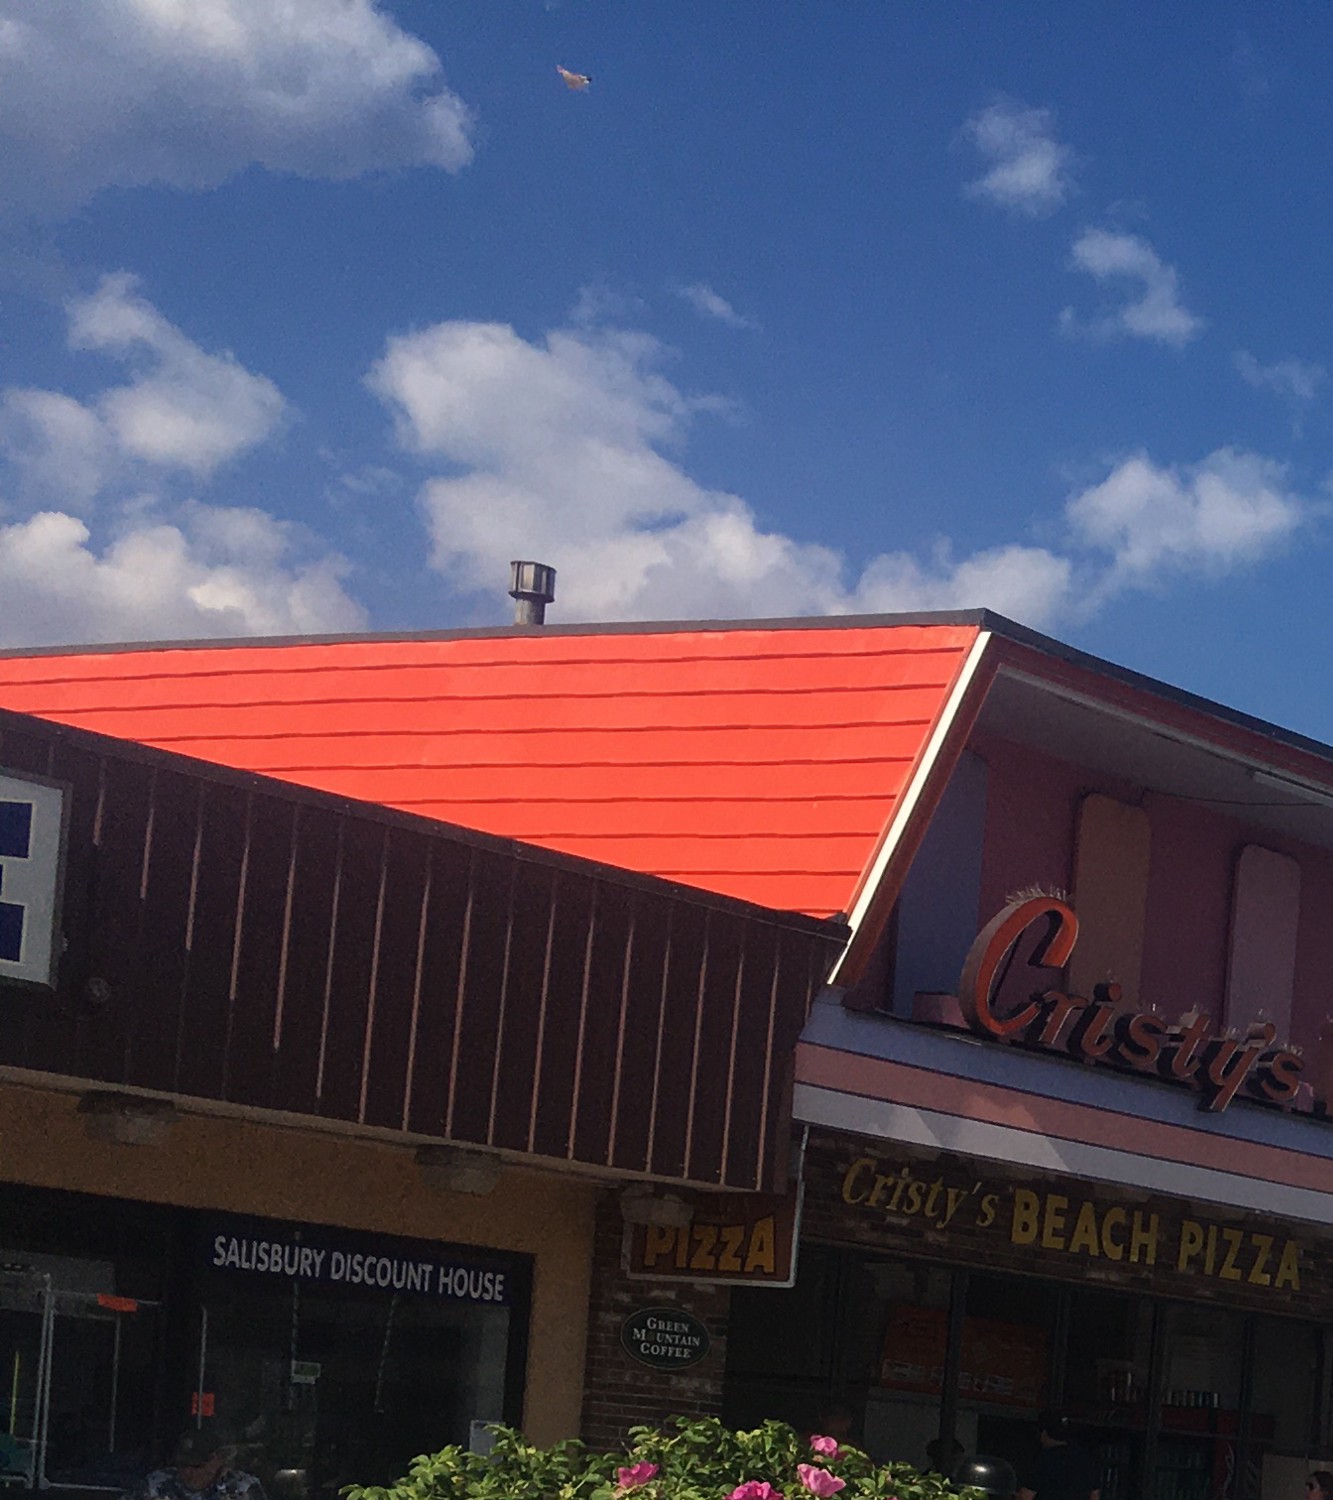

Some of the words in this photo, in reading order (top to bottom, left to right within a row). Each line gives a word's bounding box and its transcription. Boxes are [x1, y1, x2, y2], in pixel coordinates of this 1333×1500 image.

[960, 896, 1304, 1113] Cristy's
[643, 1214, 776, 1274] PIZZA
[841, 1157, 999, 1229] Cristy's
[1010, 1187, 1159, 1265] BEACH
[1178, 1220, 1300, 1291] PIZZA
[213, 1235, 326, 1278] SALISBURY
[330, 1251, 434, 1293] DISCOUNT
[438, 1266, 505, 1302] HOUSE
[632, 1328, 701, 1347] MUNTAIN
[639, 1341, 692, 1359] COFFEE
[646, 1317, 690, 1334] GREEN
